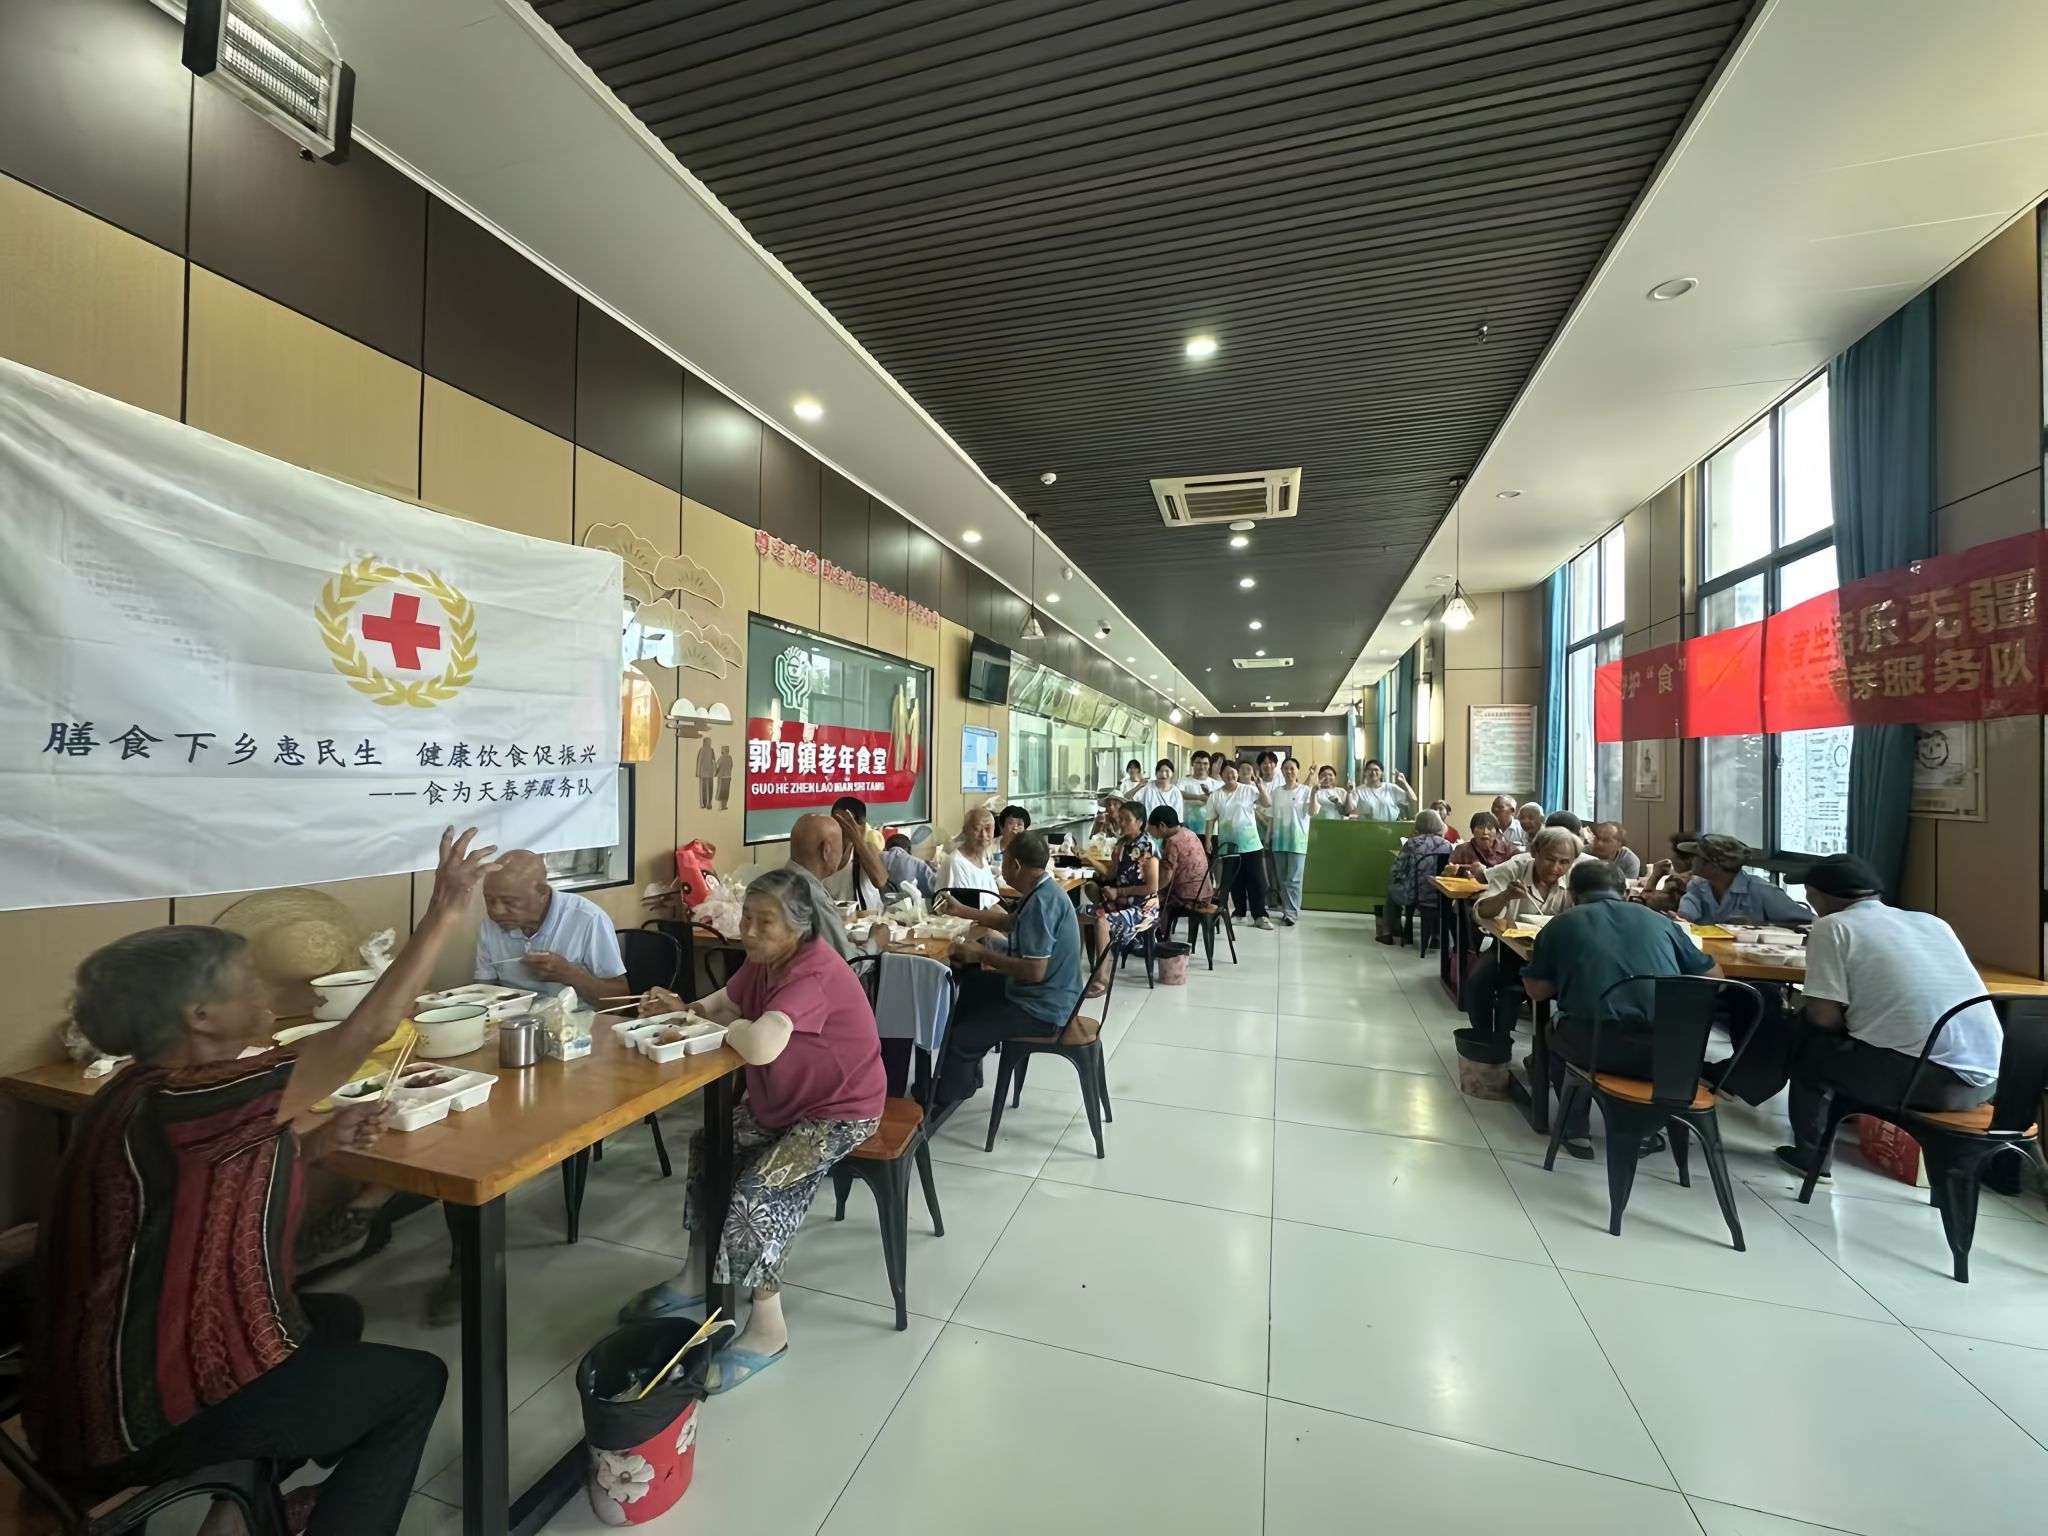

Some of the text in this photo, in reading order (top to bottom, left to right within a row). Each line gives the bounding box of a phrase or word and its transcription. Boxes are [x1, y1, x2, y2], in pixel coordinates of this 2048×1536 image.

[42, 721, 597, 768] 膳食下乡惠民生 健康饮食促振兴
[748, 738, 887, 775] 郭河镇老年食堂
[751, 782, 775, 795] GUO
[776, 782, 789, 794] HE
[790, 782, 815, 794] ZHEN
[816, 781, 833, 793] LAO
